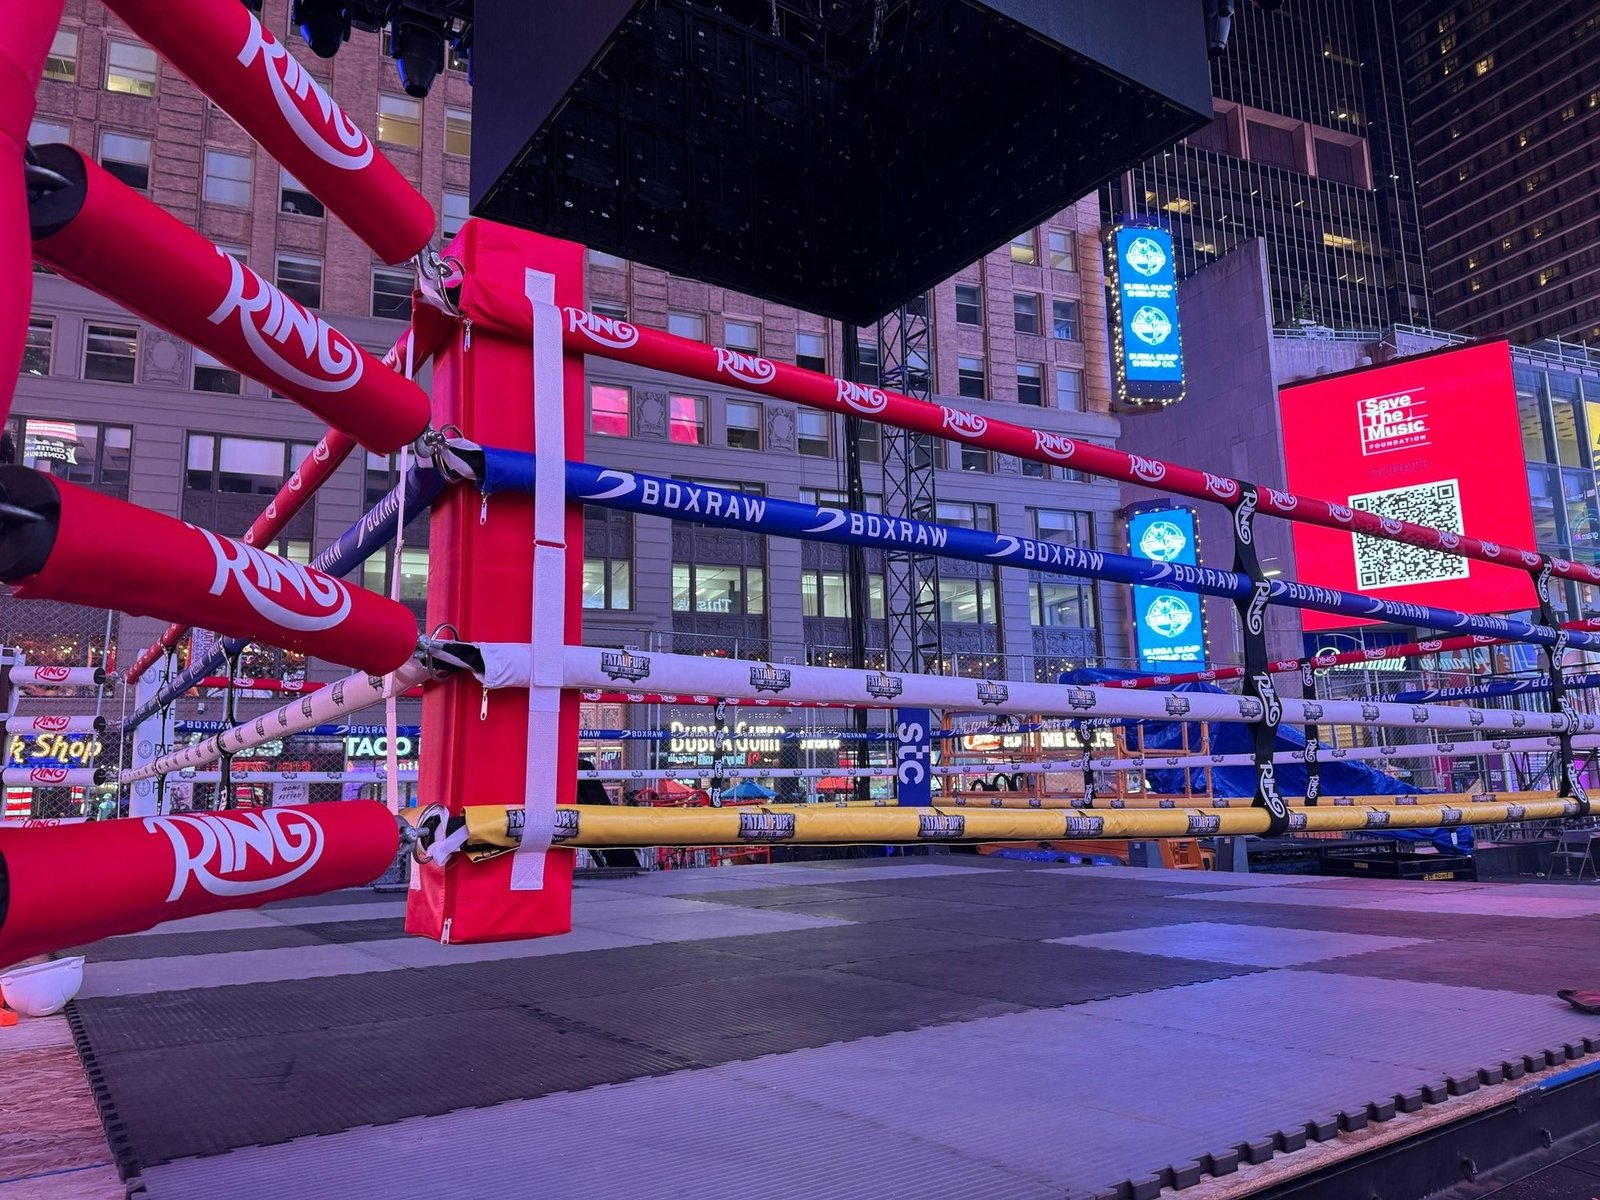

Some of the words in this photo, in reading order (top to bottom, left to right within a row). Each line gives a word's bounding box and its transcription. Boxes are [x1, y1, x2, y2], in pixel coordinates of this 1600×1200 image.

[237, 9, 374, 170] RING
[207, 245, 364, 392] RING
[563, 307, 638, 349] RING
[713, 347, 776, 384] RING
[834, 378, 887, 414] RING
[1365, 395, 1411, 412] Save
[940, 406, 987, 437] RING
[1366, 410, 1403, 425] The
[1368, 420, 1425, 440] Music
[1370, 434, 1426, 449] FOUNDATION
[1032, 430, 1075, 459] RING
[1128, 454, 1165, 482] RING
[1370, 459, 1429, 477] DONATE
[1203, 472, 1237, 498] RING
[642, 478, 766, 523] BOXRAW
[1267, 488, 1297, 510] RING
[1235, 489, 1257, 545] RING
[850, 512, 947, 548] BOXRAW
[1023, 543, 1104, 571] BOXRAW
[185, 522, 351, 631] RING
[1174, 563, 1239, 591] BOXRAW
[1289, 582, 1342, 606] BOXRAW
[1247, 579, 1270, 636] RING
[1386, 601, 1430, 620] BOXRAW
[1470, 614, 1508, 631] BOXRAW
[1363, 648, 1386, 659] RING
[1418, 640, 1442, 651] RING
[603, 653, 627, 667] FATAL
[628, 656, 649, 669] FURY
[1276, 661, 1297, 671] RING
[1316, 656, 1337, 666] RING
[35, 666, 71, 681] RING
[158, 670, 177, 682] PF
[752, 667, 771, 680] FATAL
[772, 669, 790, 681] FURY
[1301, 662, 1313, 687] RING
[1532, 675, 1587, 687] BORAW
[1253, 672, 1282, 727] RING
[1441, 685, 1490, 696] BOXRAW
[33, 716, 70, 731] RING
[32, 733, 102, 764] Shop
[155, 744, 173, 755] PF
[346, 737, 411, 756] TACO
[898, 722, 930, 785] stc
[1305, 737, 1317, 763] RING
[30, 768, 69, 783] RING
[153, 781, 171, 793] PF
[1307, 774, 1320, 799] RING
[1260, 760, 1286, 818] RING
[741, 814, 768, 830] FATAL
[770, 814, 795, 830] FURY
[921, 815, 943, 829] FATAL
[944, 815, 964, 830] FURY
[143, 808, 324, 902] RING
